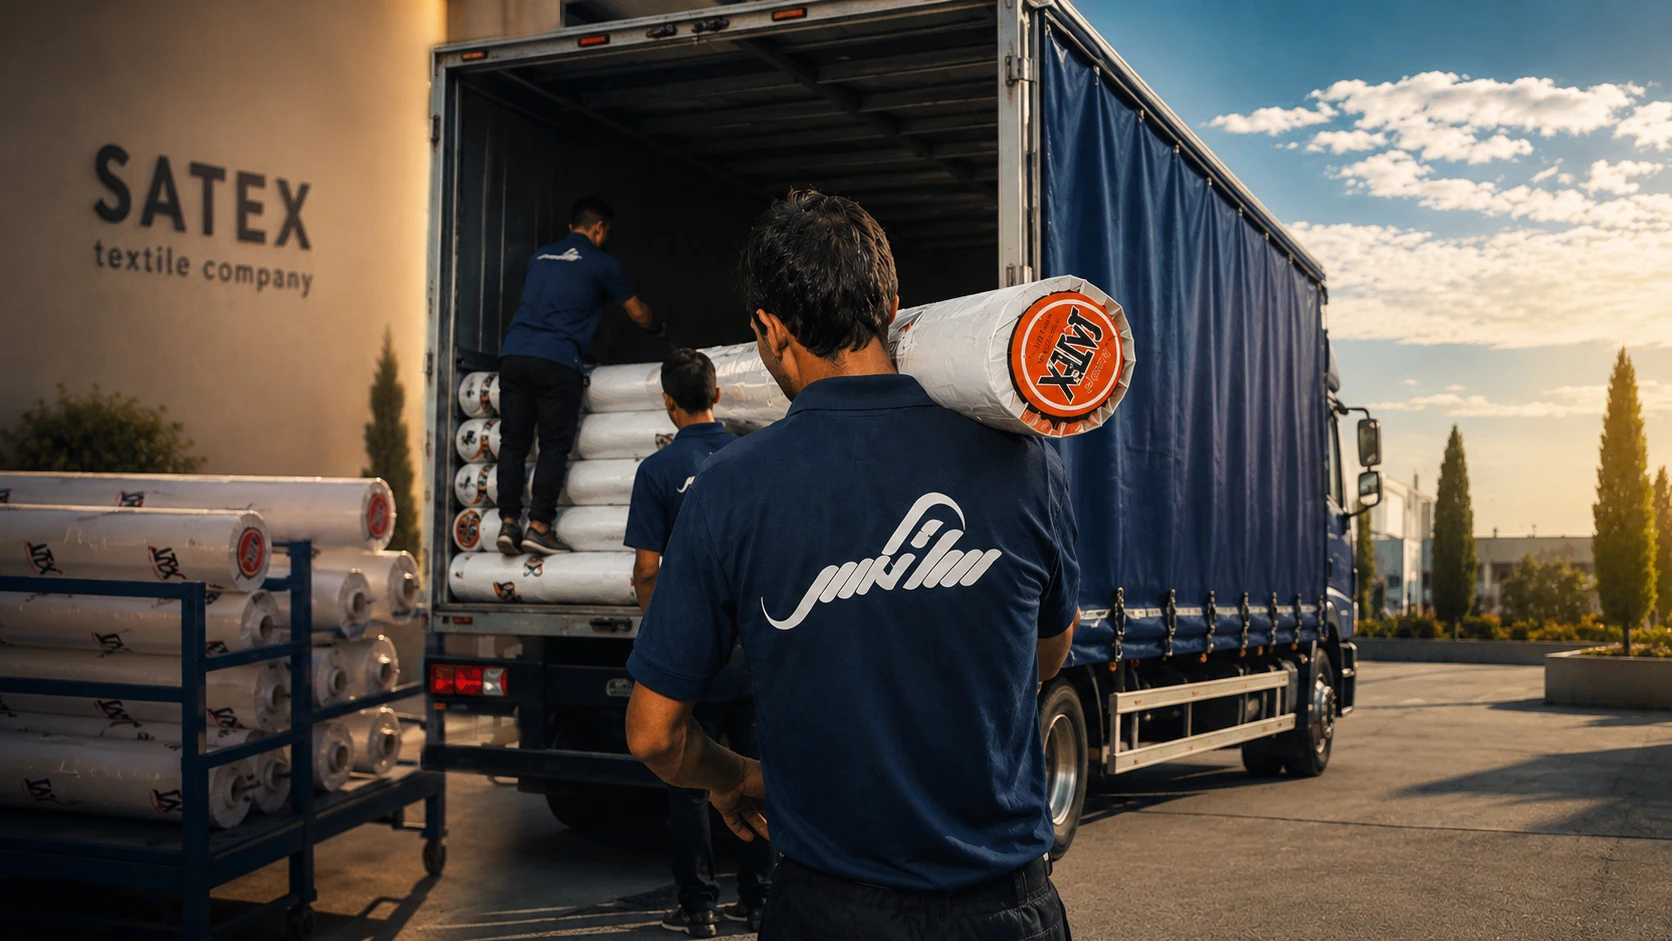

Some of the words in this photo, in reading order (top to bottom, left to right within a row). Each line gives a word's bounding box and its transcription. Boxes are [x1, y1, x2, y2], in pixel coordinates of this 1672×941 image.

[93, 144, 311, 250] SATEX
[94, 241, 190, 276] textile
[202, 259, 314, 298] company
